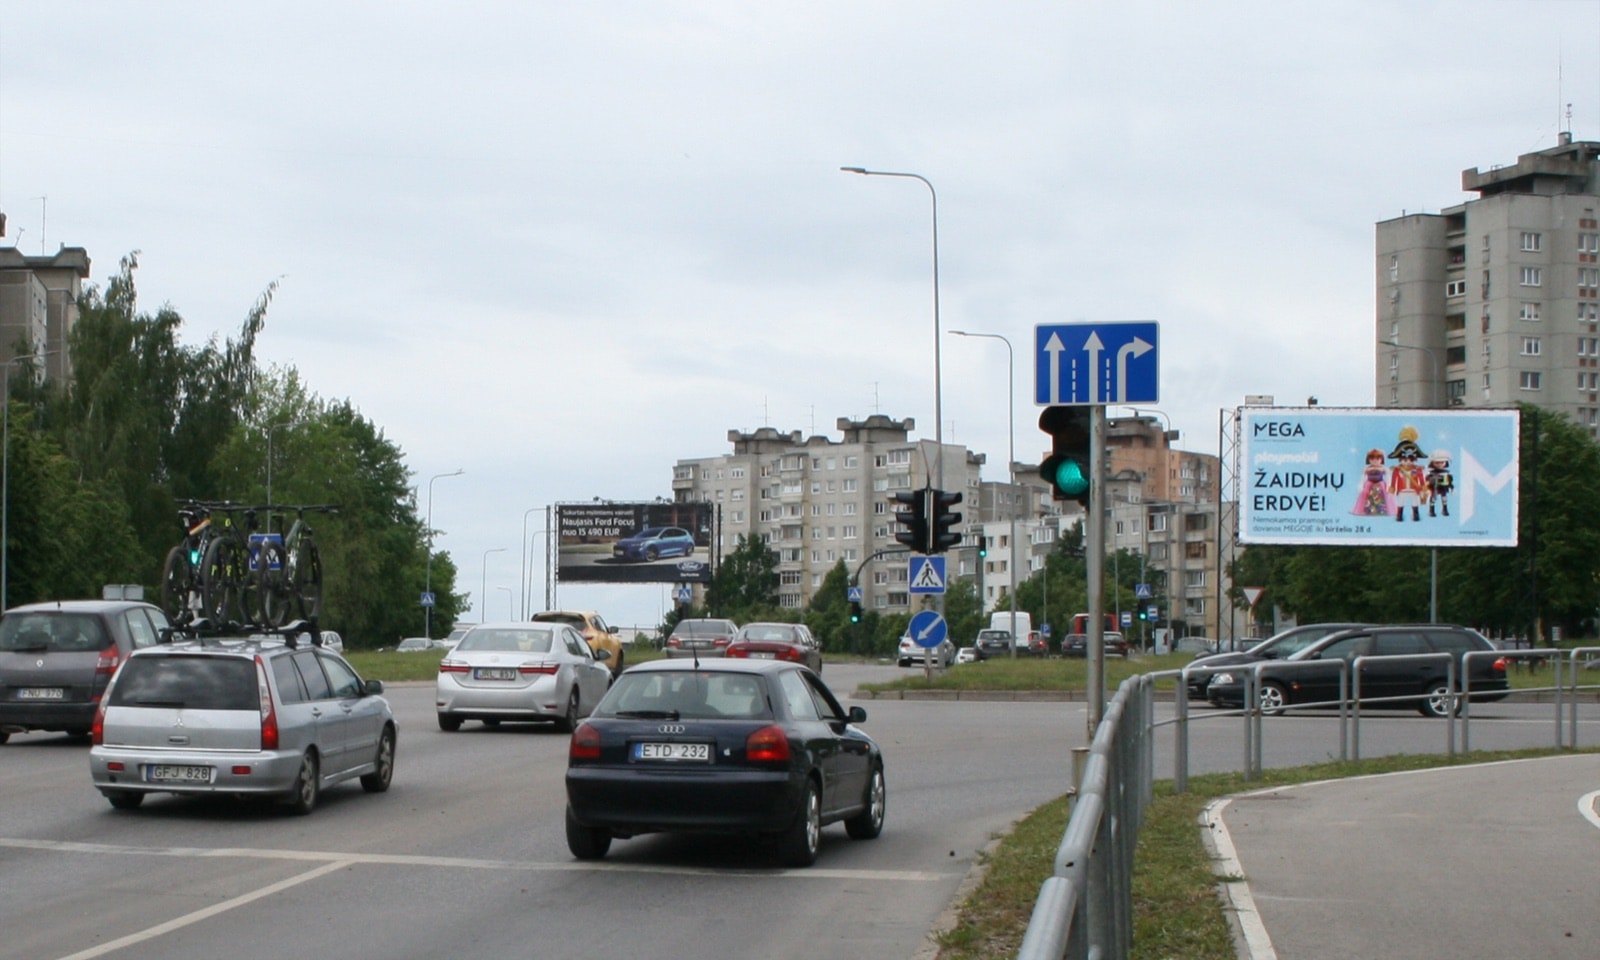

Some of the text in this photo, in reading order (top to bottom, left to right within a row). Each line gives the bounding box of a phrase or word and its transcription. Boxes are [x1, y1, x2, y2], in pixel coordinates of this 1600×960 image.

[1254, 422, 1305, 437] MEGA
[1254, 451, 1319, 465] playmobil
[1254, 468, 1344, 492] ŽAIDIMŲ
[1254, 492, 1326, 511] ERDVĖ!
[562, 518, 635, 527] Naujasis Ford Focus
[1253, 516, 1297, 524] Nemokamos
[578, 528, 587, 536] 15
[588, 528, 603, 536] 490
[604, 528, 620, 536] EUR
[1354, 525, 1365, 533] 28
[643, 744, 706, 758] ETD 232
[154, 766, 208, 779] GFJ 828
